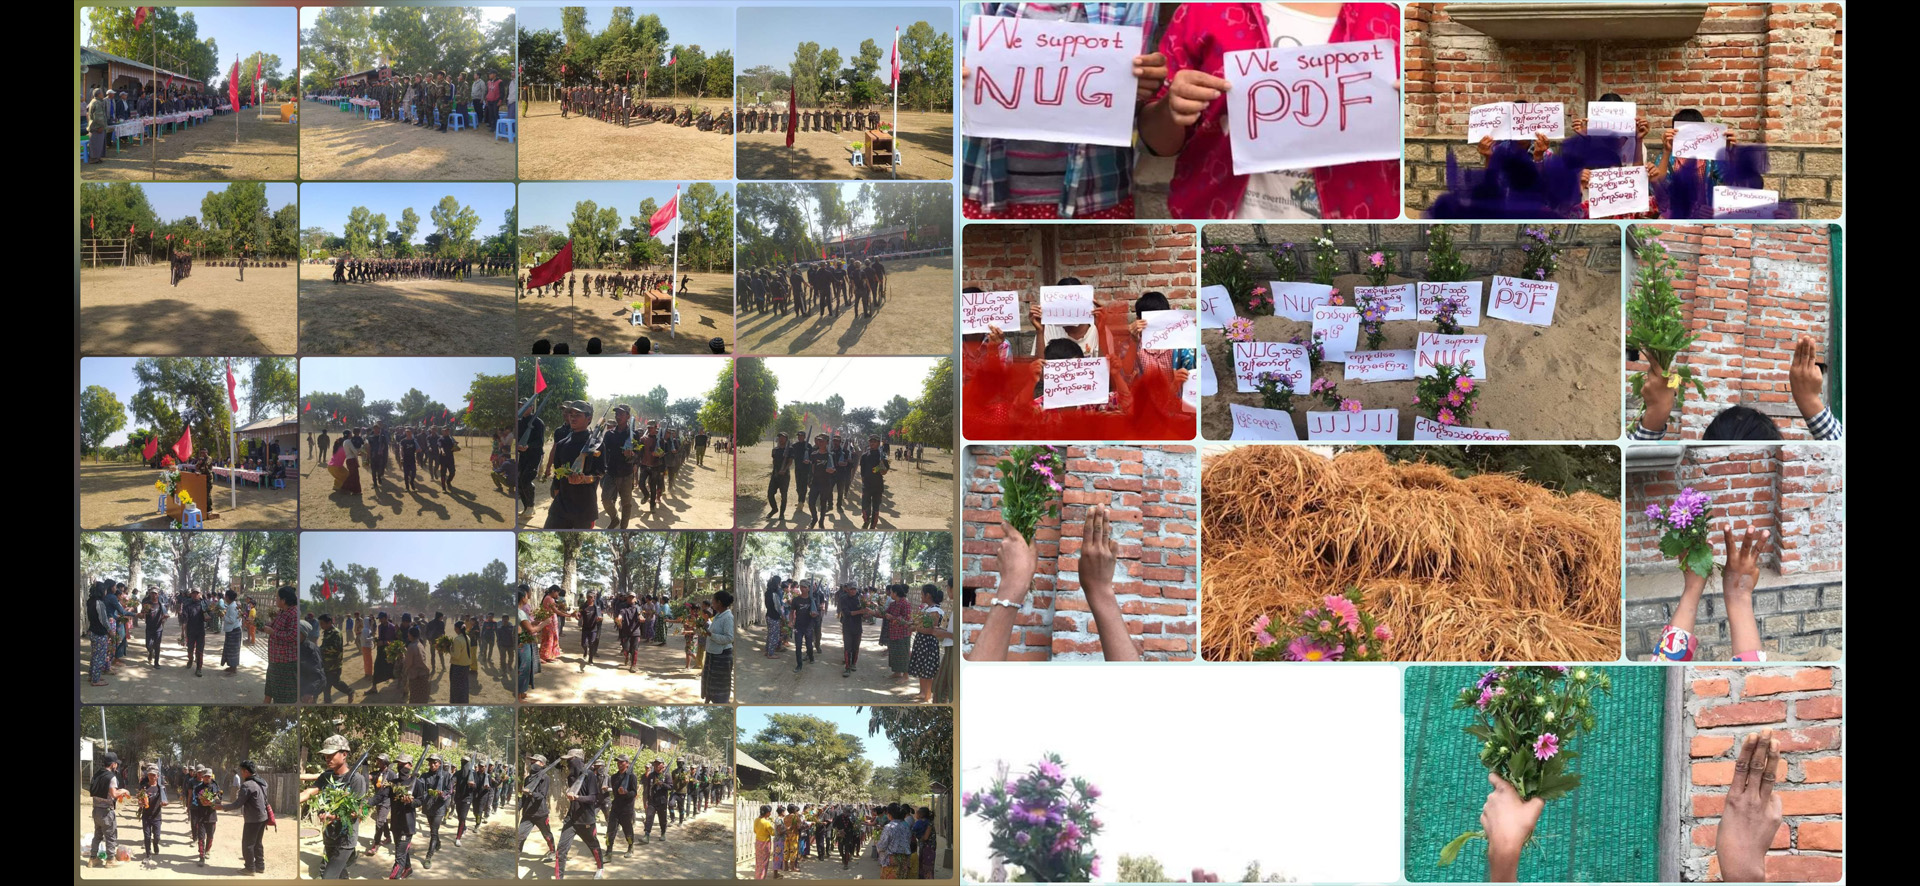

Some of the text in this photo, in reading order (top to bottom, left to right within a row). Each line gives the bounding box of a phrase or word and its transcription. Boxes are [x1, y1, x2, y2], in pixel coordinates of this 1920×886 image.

[978, 16, 1124, 62] We support
[1235, 44, 1384, 78] We support
[974, 66, 1113, 110] NUG
[1247, 71, 1372, 140] PDF
[1512, 103, 1543, 115] NUG
[1420, 283, 1448, 297] PDF
[1497, 276, 1555, 293] We support
[962, 292, 996, 307] NUG
[1201, 296, 1219, 315] DF
[1495, 287, 1548, 314] PDF
[1420, 332, 1480, 349] We support
[1237, 342, 1280, 359] NUG
[1419, 349, 1476, 368] NUG
